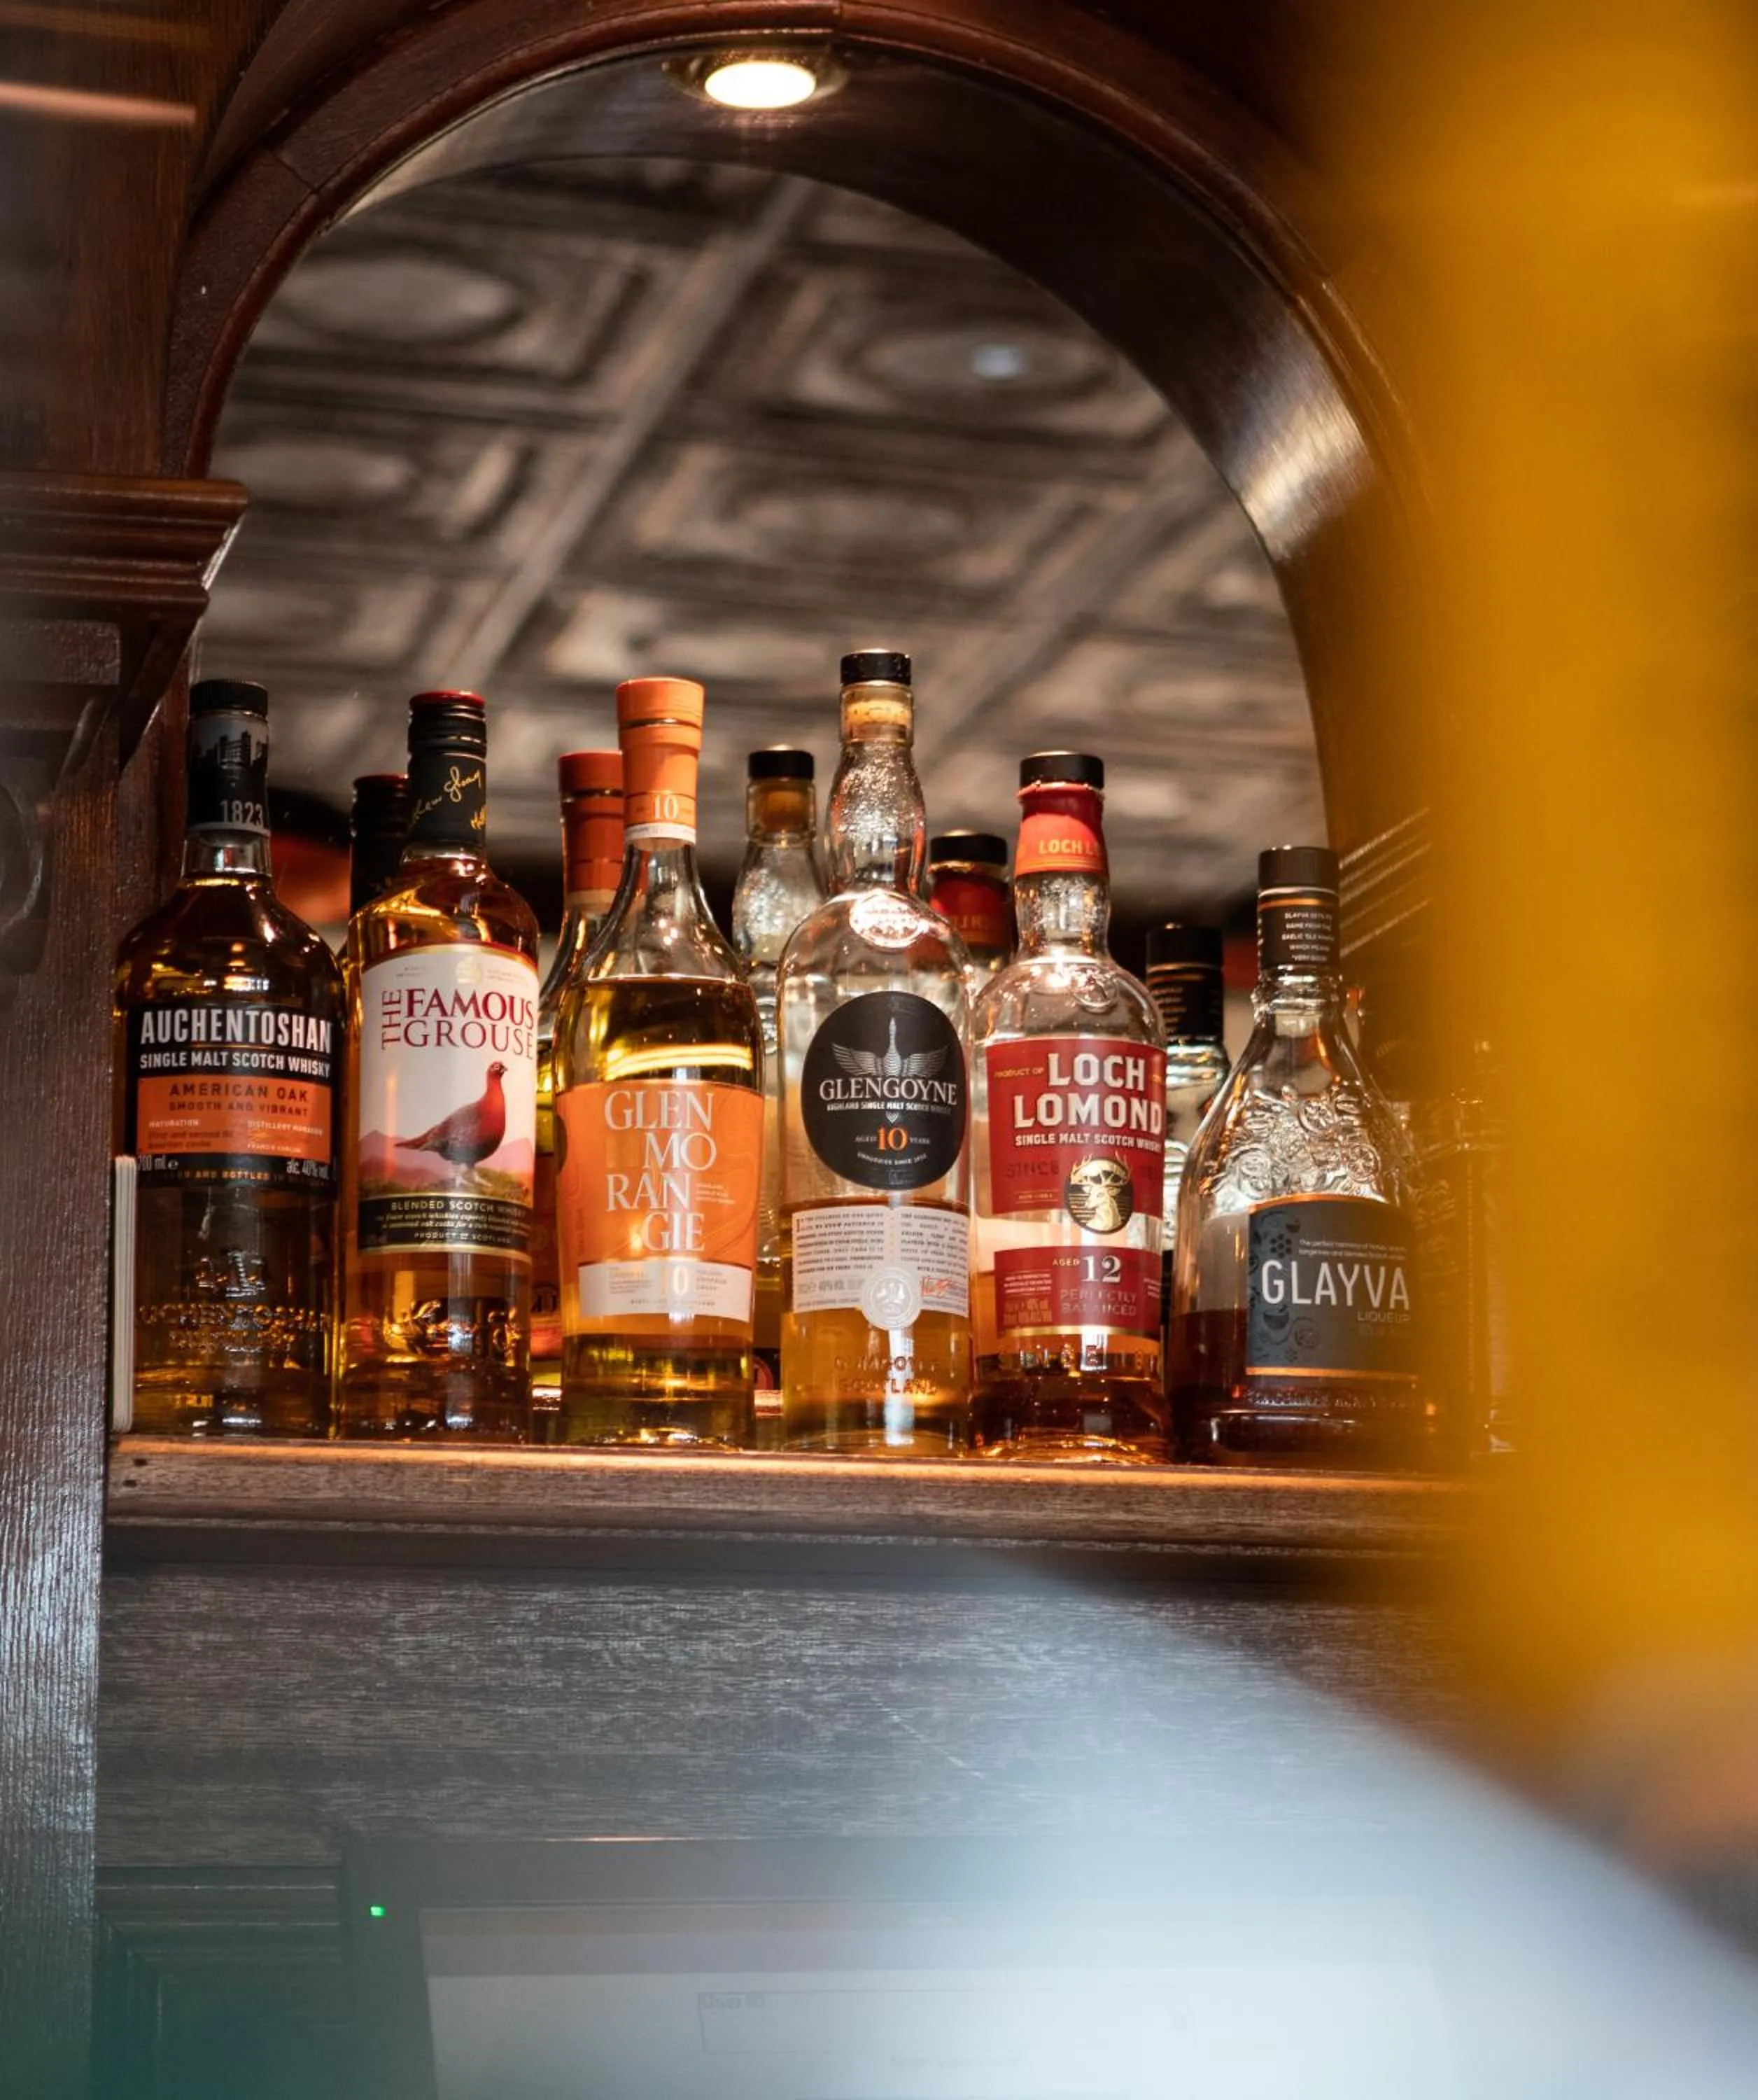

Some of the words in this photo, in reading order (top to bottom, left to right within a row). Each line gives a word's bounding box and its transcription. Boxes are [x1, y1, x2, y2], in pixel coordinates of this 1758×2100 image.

[220, 800, 264, 827] 1823
[654, 795, 678, 819] 10
[1039, 839, 1083, 855] LOCH
[140, 1009, 332, 1054] AUCHENTOSHAN
[381, 989, 402, 1050] THE
[405, 988, 534, 1030] FAMOUS
[403, 1019, 533, 1060] GROUSE
[140, 1052, 187, 1069] SINGLE
[191, 1051, 229, 1066] MALT
[232, 1052, 284, 1070] SCOTCH
[288, 1056, 330, 1079] WHISKY
[994, 1069, 1029, 1079] PRODUCT
[1032, 1067, 1044, 1075] OF
[1048, 1053, 1146, 1092] LOCH
[169, 1084, 268, 1098] AMERICAN
[276, 1086, 308, 1103] OAK
[820, 1077, 957, 1105] GLENGOYNE
[169, 1101, 221, 1112] SMOOTH
[227, 1102, 253, 1112] AND
[259, 1104, 309, 1116] VIBRANT
[604, 1090, 714, 1132] GLEN
[827, 1102, 859, 1112] HIGHLAND
[860, 1101, 885, 1110] SINGLE
[886, 1101, 904, 1110] MALT
[905, 1102, 929, 1112] SCOTCH
[1013, 1093, 1162, 1135] LOMOND
[642, 1132, 717, 1171] MO
[855, 1135, 877, 1143] AGED
[877, 1125, 908, 1152] 10
[909, 1137, 930, 1145] YEARS
[1015, 1134, 1056, 1147] SINGLE
[1059, 1133, 1090, 1144] MALT
[1094, 1133, 1134, 1147] SCOTCH
[605, 1173, 693, 1211] RAN
[391, 1200, 444, 1211] BLENDED
[449, 1200, 494, 1212] SCOTCH
[414, 1231, 456, 1240] PRODUCT
[640, 1212, 705, 1252] GIE
[1052, 1258, 1081, 1267] AGED
[1081, 1254, 1121, 1283] 12
[1060, 1289, 1137, 1304] PERFECTLY
[1262, 1259, 1409, 1310] GLAYVA
[1062, 1302, 1137, 1317] BALANCED
